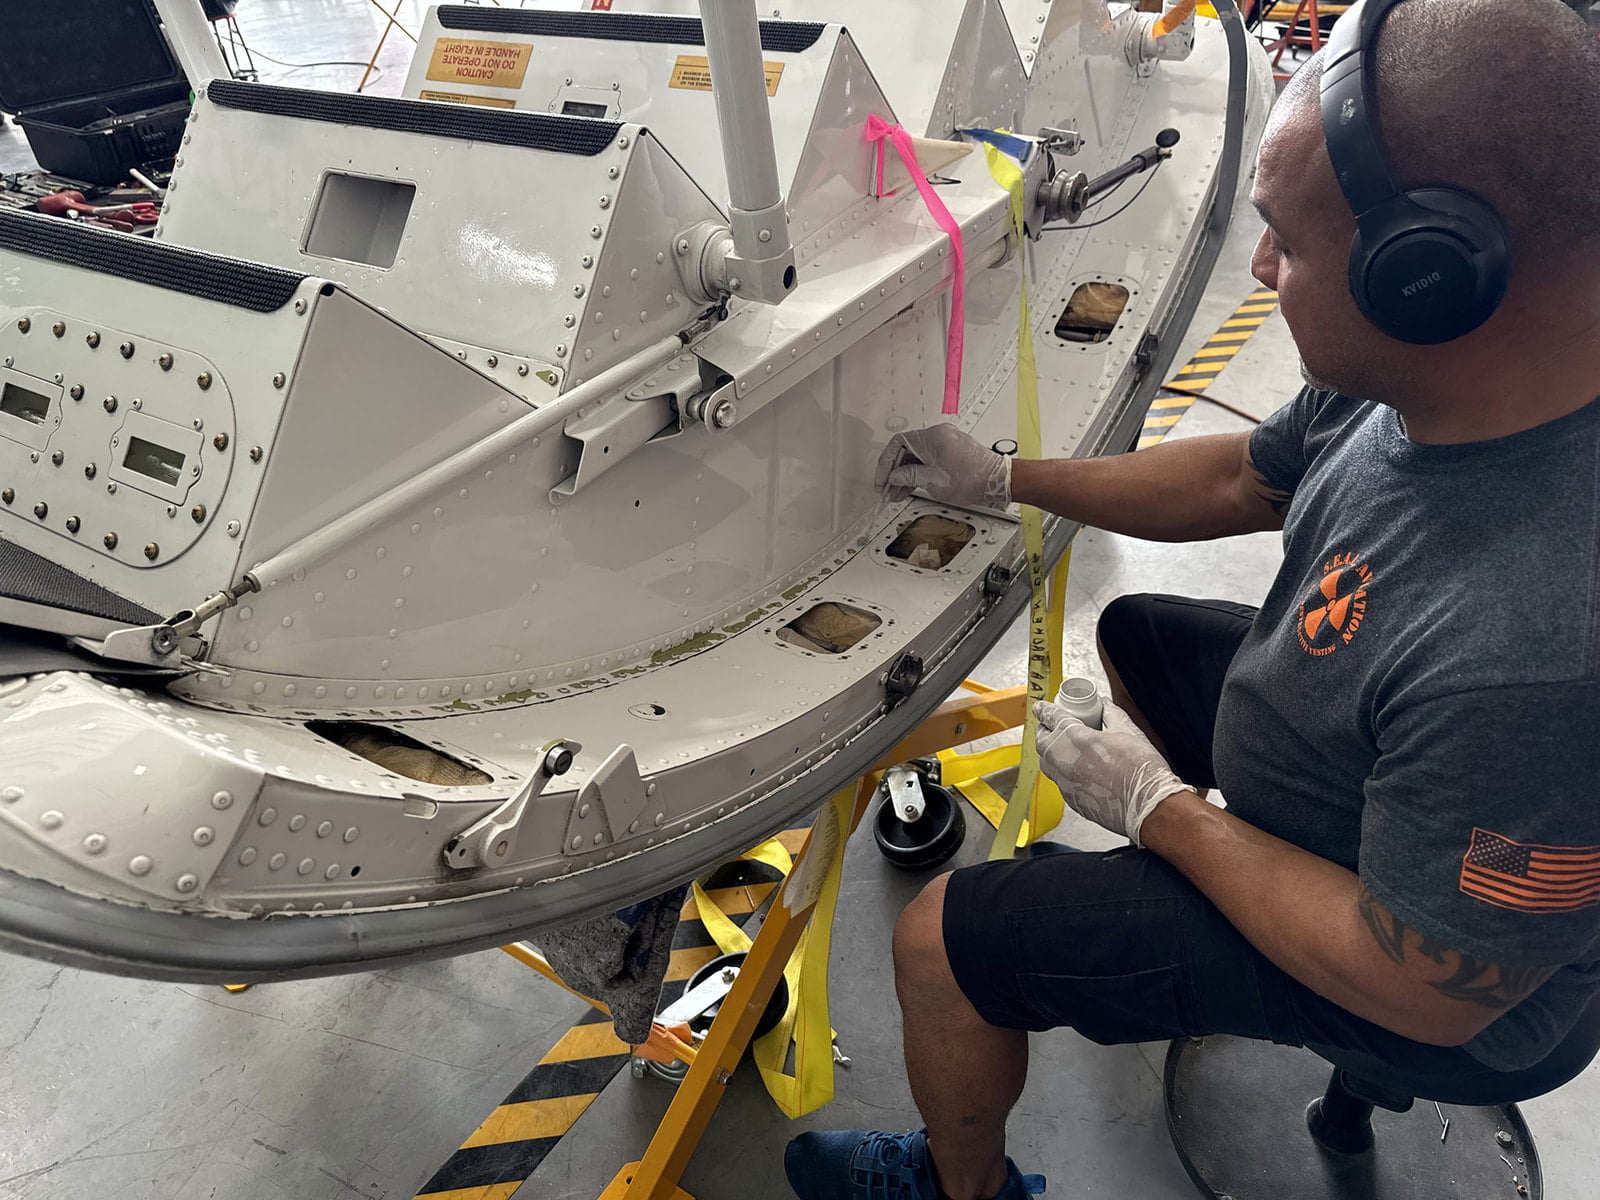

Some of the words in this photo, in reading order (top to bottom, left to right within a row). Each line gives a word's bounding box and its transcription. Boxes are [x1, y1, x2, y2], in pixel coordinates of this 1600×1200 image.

[443, 43, 474, 55] FLIGHT
[474, 45, 484, 56] IN
[484, 47, 521, 59] HANDLE
[442, 54, 481, 67] OPERATE
[481, 58, 501, 70] NOT
[502, 60, 516, 70] DO
[455, 67, 494, 80] CAUTION
[1401, 271, 1441, 297] KVIDIO
[1308, 642, 1338, 657] TESTING
